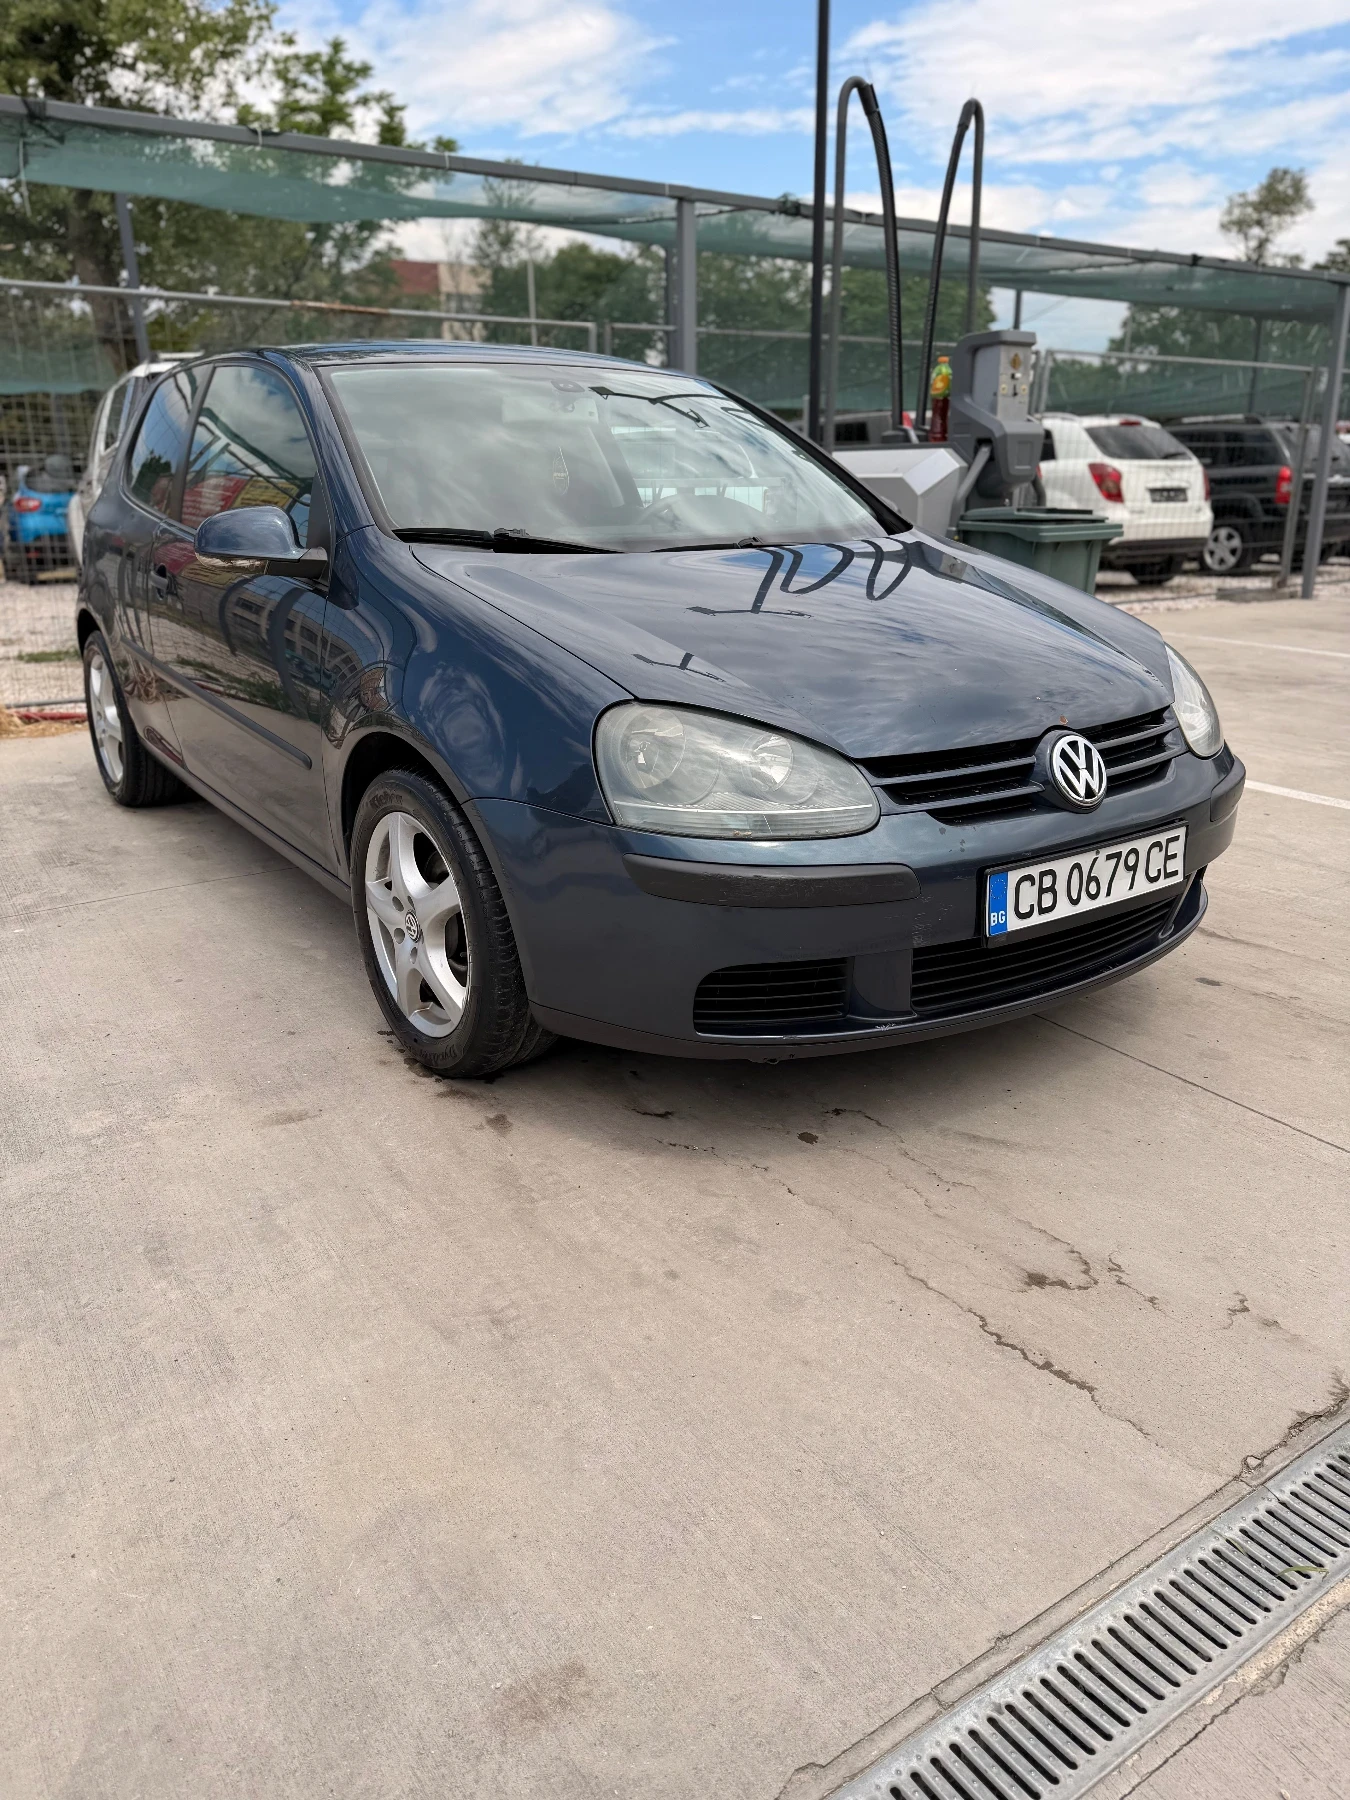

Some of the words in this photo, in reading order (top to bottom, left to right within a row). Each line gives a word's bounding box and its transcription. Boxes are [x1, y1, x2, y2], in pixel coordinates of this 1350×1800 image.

[1054, 736, 1106, 801] VW
[1013, 868, 1058, 920] CB
[1067, 847, 1140, 906] 0679
[1145, 834, 1181, 884] CE
[990, 910, 1006, 926] BG
